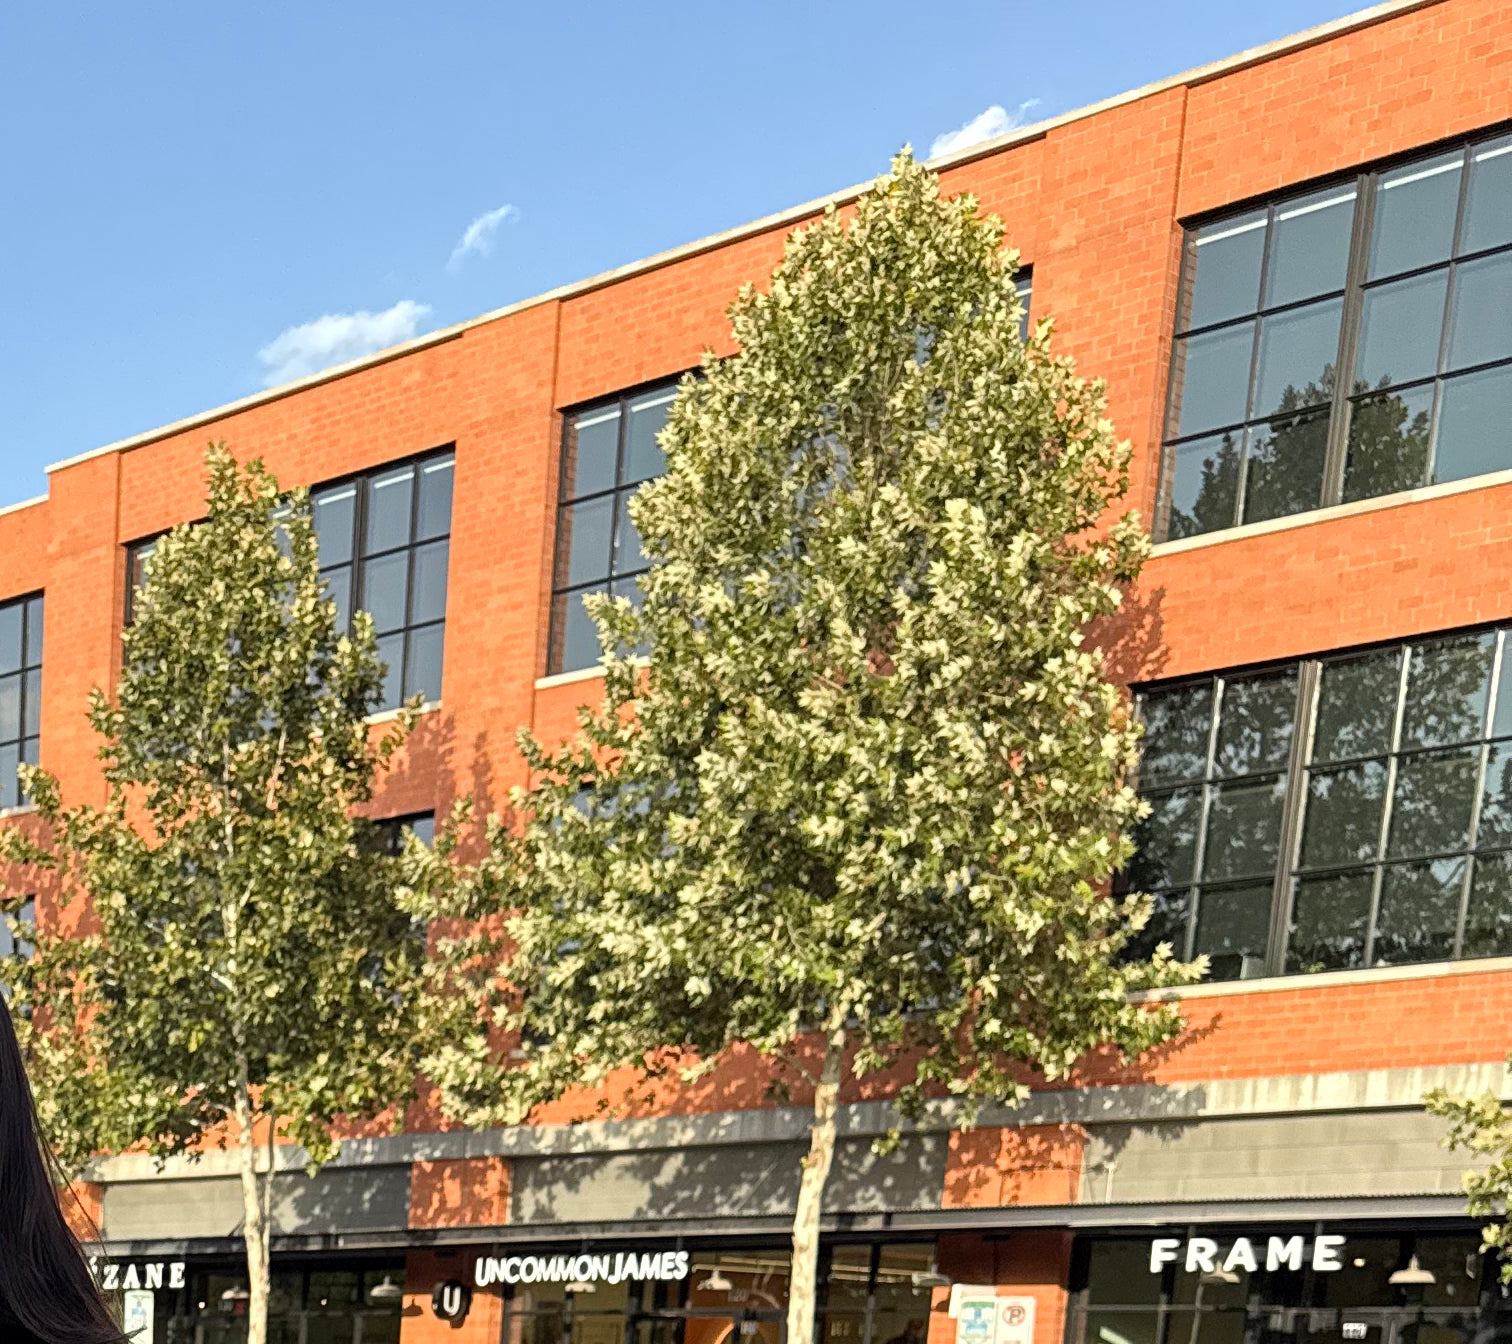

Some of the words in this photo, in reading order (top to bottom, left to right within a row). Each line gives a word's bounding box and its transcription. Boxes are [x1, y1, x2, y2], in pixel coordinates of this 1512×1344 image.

[606, 1251, 689, 1285] JAMES
[1150, 1234, 1346, 1273] FRAME
[88, 1256, 186, 1290] ZANE
[442, 1284, 463, 1317] U
